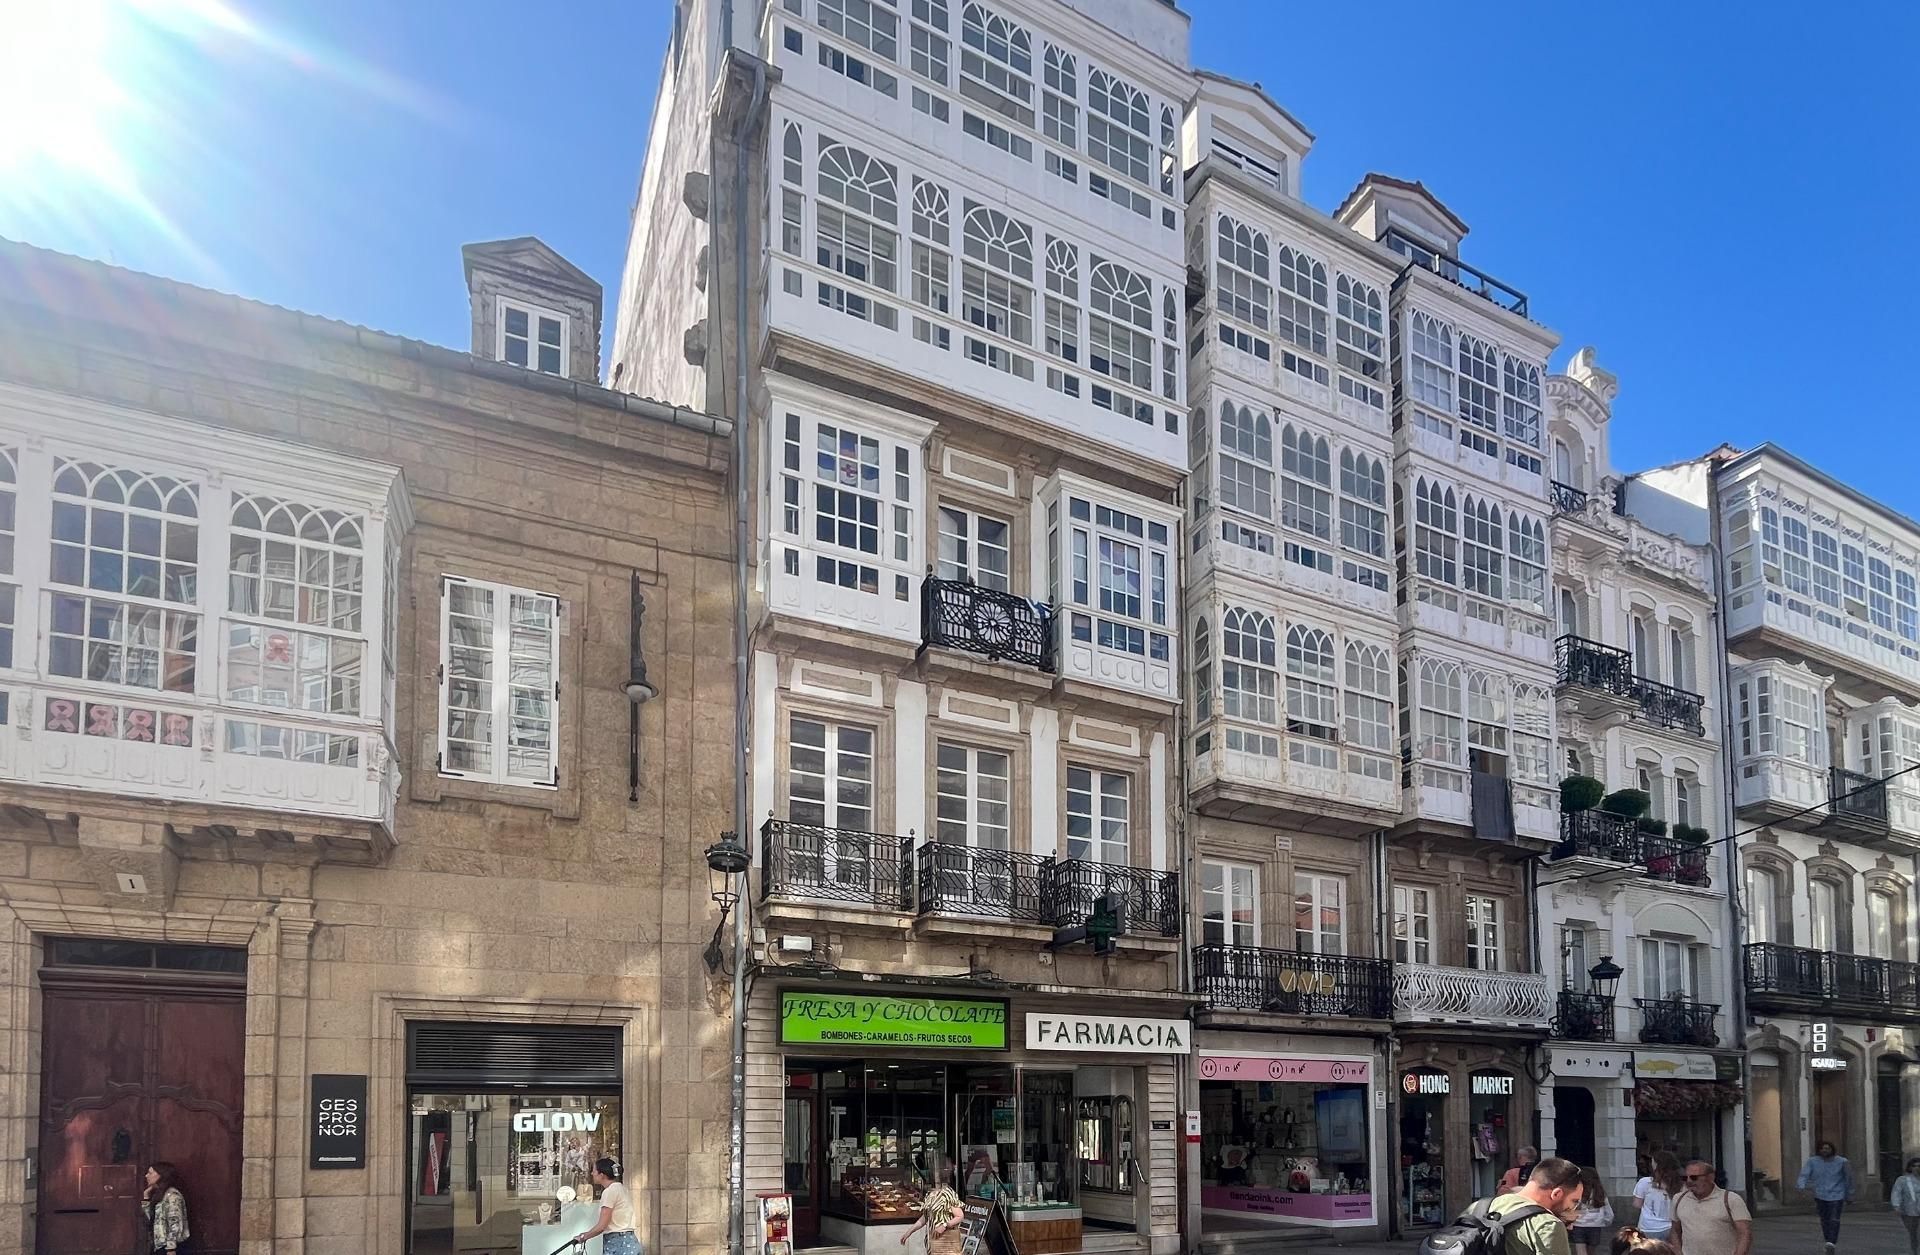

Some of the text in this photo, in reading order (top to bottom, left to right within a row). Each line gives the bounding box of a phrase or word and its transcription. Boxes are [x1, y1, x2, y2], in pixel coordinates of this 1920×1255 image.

[782, 1000, 1006, 1023] FRESA Y CHOCOLATE
[948, 1034, 972, 1043] SECOS
[1038, 1020, 1183, 1048] FARMACIA
[1420, 1075, 1514, 1095] HONG MARKET
[319, 1099, 358, 1111] GES
[319, 1112, 358, 1123] PRO
[513, 1112, 600, 1132] GLOW
[319, 1124, 357, 1136] NOR
